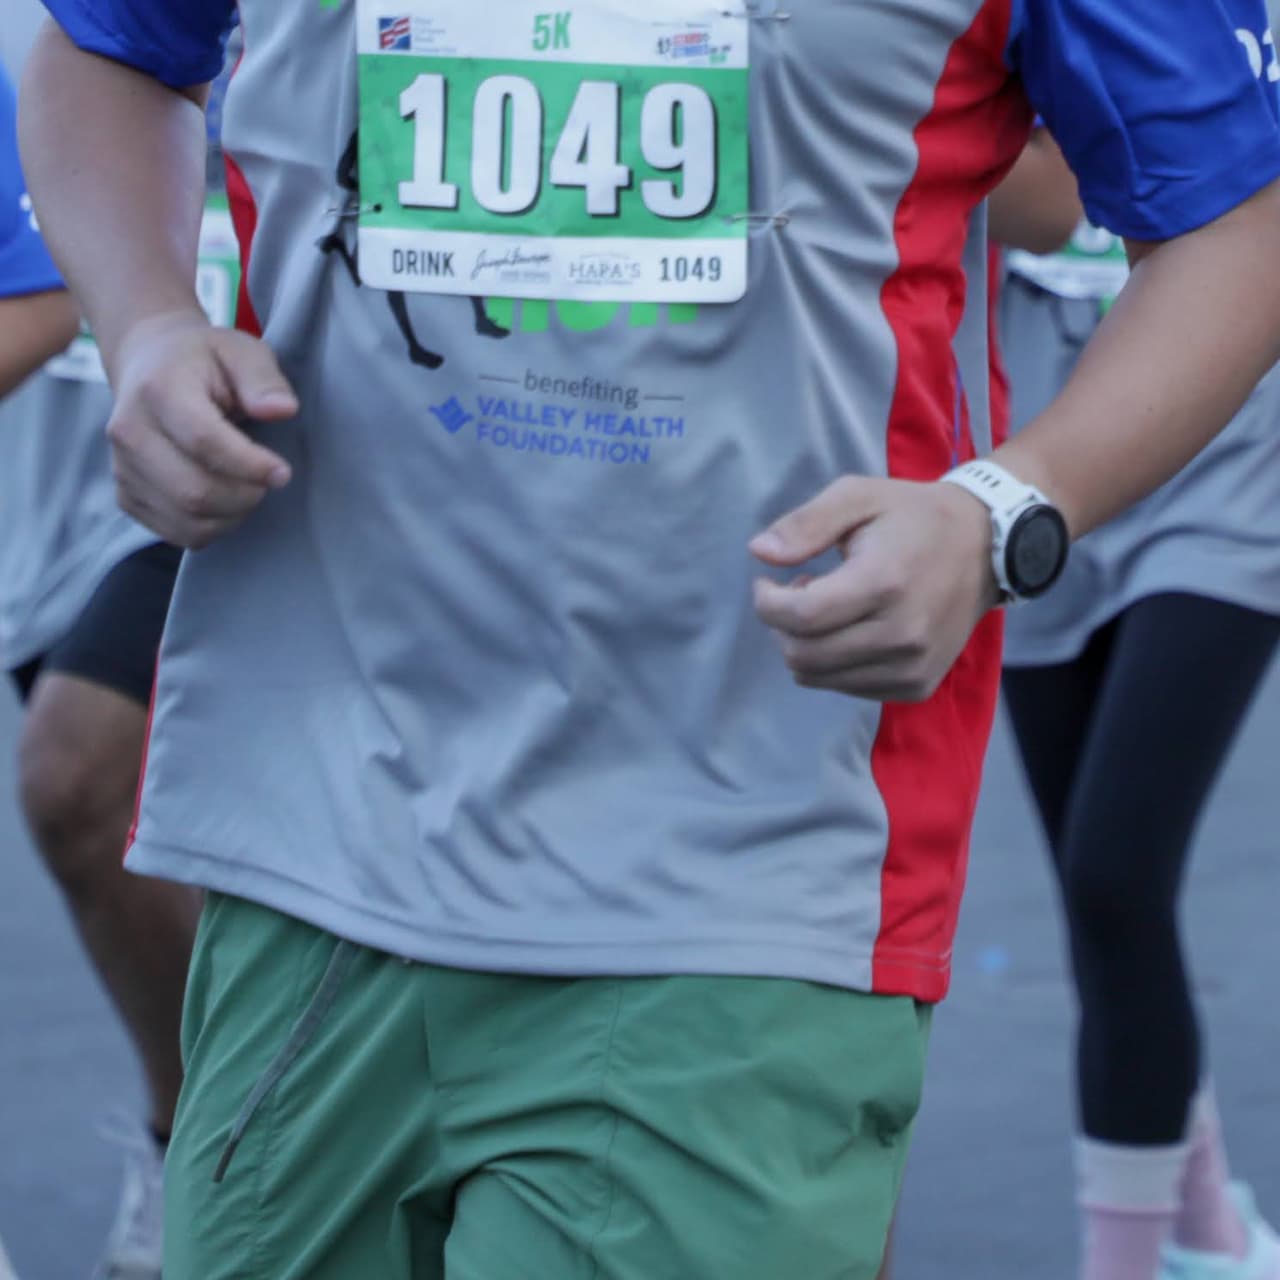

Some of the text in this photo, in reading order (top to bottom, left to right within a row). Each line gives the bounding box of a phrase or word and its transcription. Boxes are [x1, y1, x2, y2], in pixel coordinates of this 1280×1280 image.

[531, 11, 572, 52] 5K
[396, 72, 718, 219] 1049
[392, 248, 455, 279] DRINK
[659, 256, 722, 283] 1049
[523, 368, 639, 410] benefiting
[476, 395, 685, 438] VALLEY HEALTH
[477, 423, 650, 465] FOUNDATION
